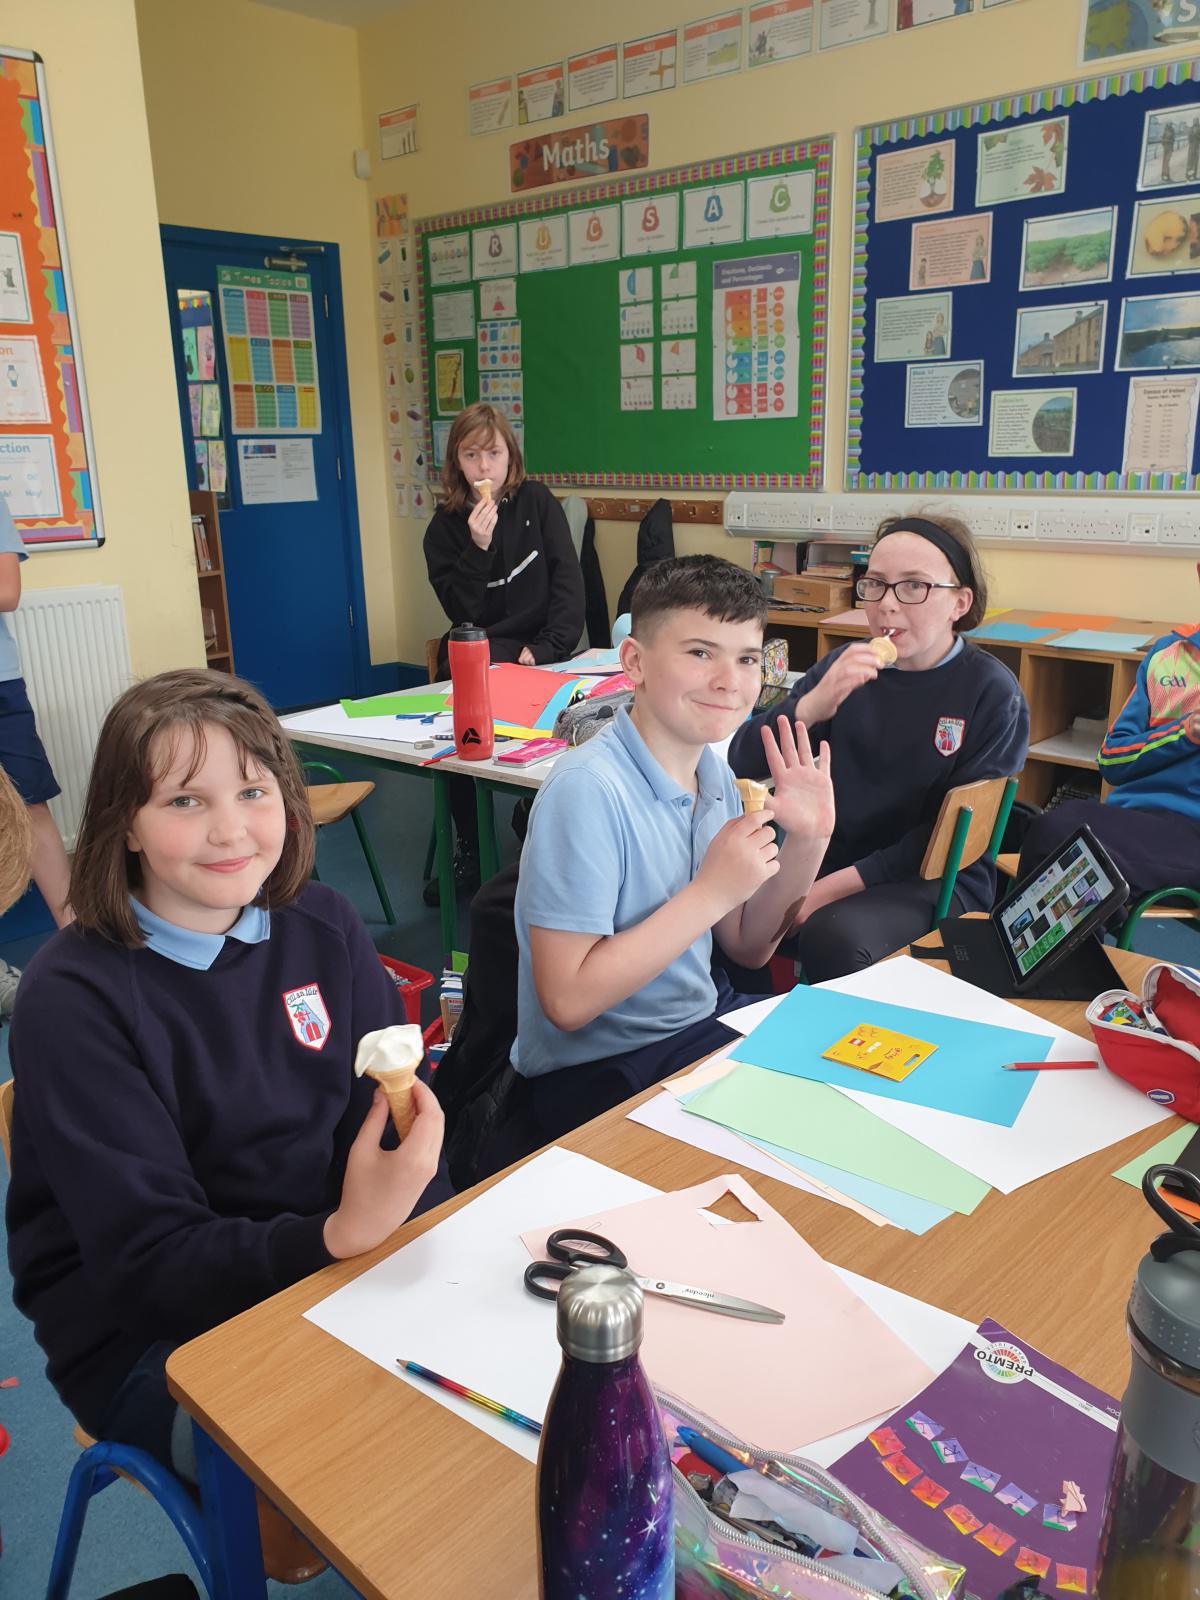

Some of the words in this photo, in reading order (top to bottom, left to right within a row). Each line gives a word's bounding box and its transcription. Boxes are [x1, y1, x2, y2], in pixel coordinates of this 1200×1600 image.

[542, 132, 610, 171] Maths
[774, 187, 786, 208] C
[645, 209, 656, 227] S
[707, 198, 720, 218] A
[589, 219, 600, 237] C
[491, 237, 501, 255] R
[977, 1350, 1034, 1377] PREMTO
